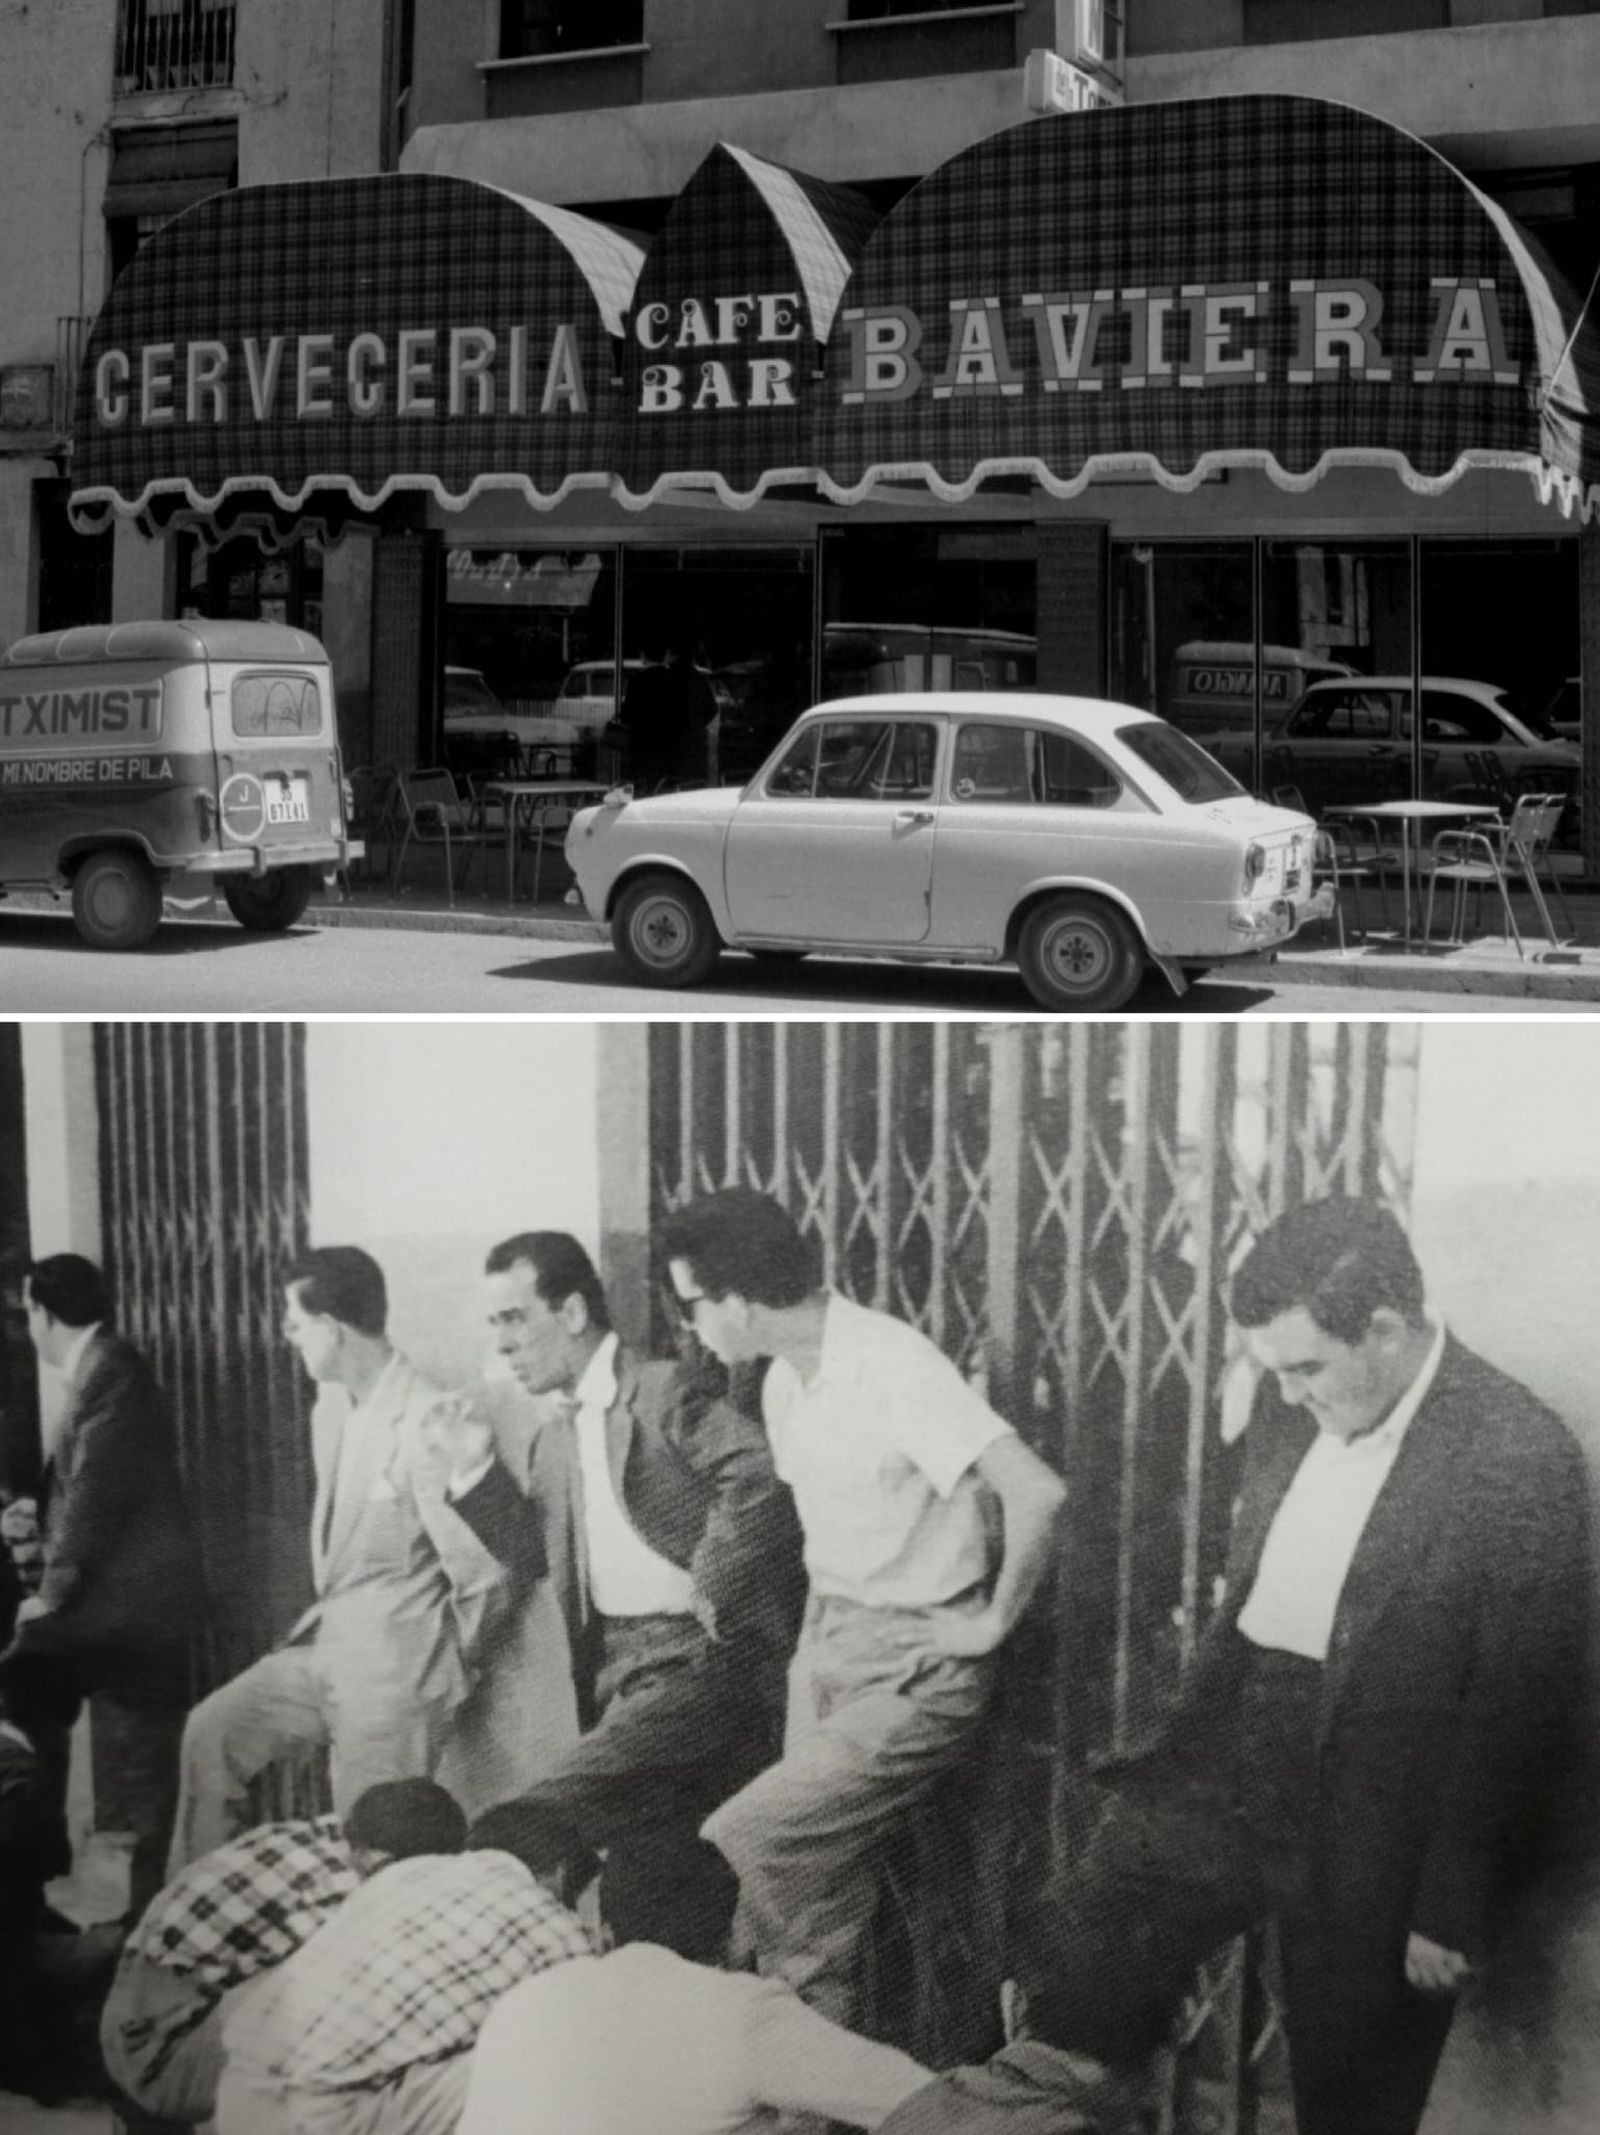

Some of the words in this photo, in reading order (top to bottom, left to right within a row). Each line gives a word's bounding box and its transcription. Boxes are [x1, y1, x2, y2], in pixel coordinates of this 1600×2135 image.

[636, 293, 801, 350] CAFE
[841, 278, 1521, 404] BAVIERA
[96, 325, 588, 427] CERVECERIA
[638, 358, 796, 413] BAR
[0, 689, 160, 736] TXIMIST
[3, 762, 20, 785] MI
[23, 760, 96, 783] NOMBRE
[99, 759, 125, 781] DE
[128, 756, 174, 781] PILA
